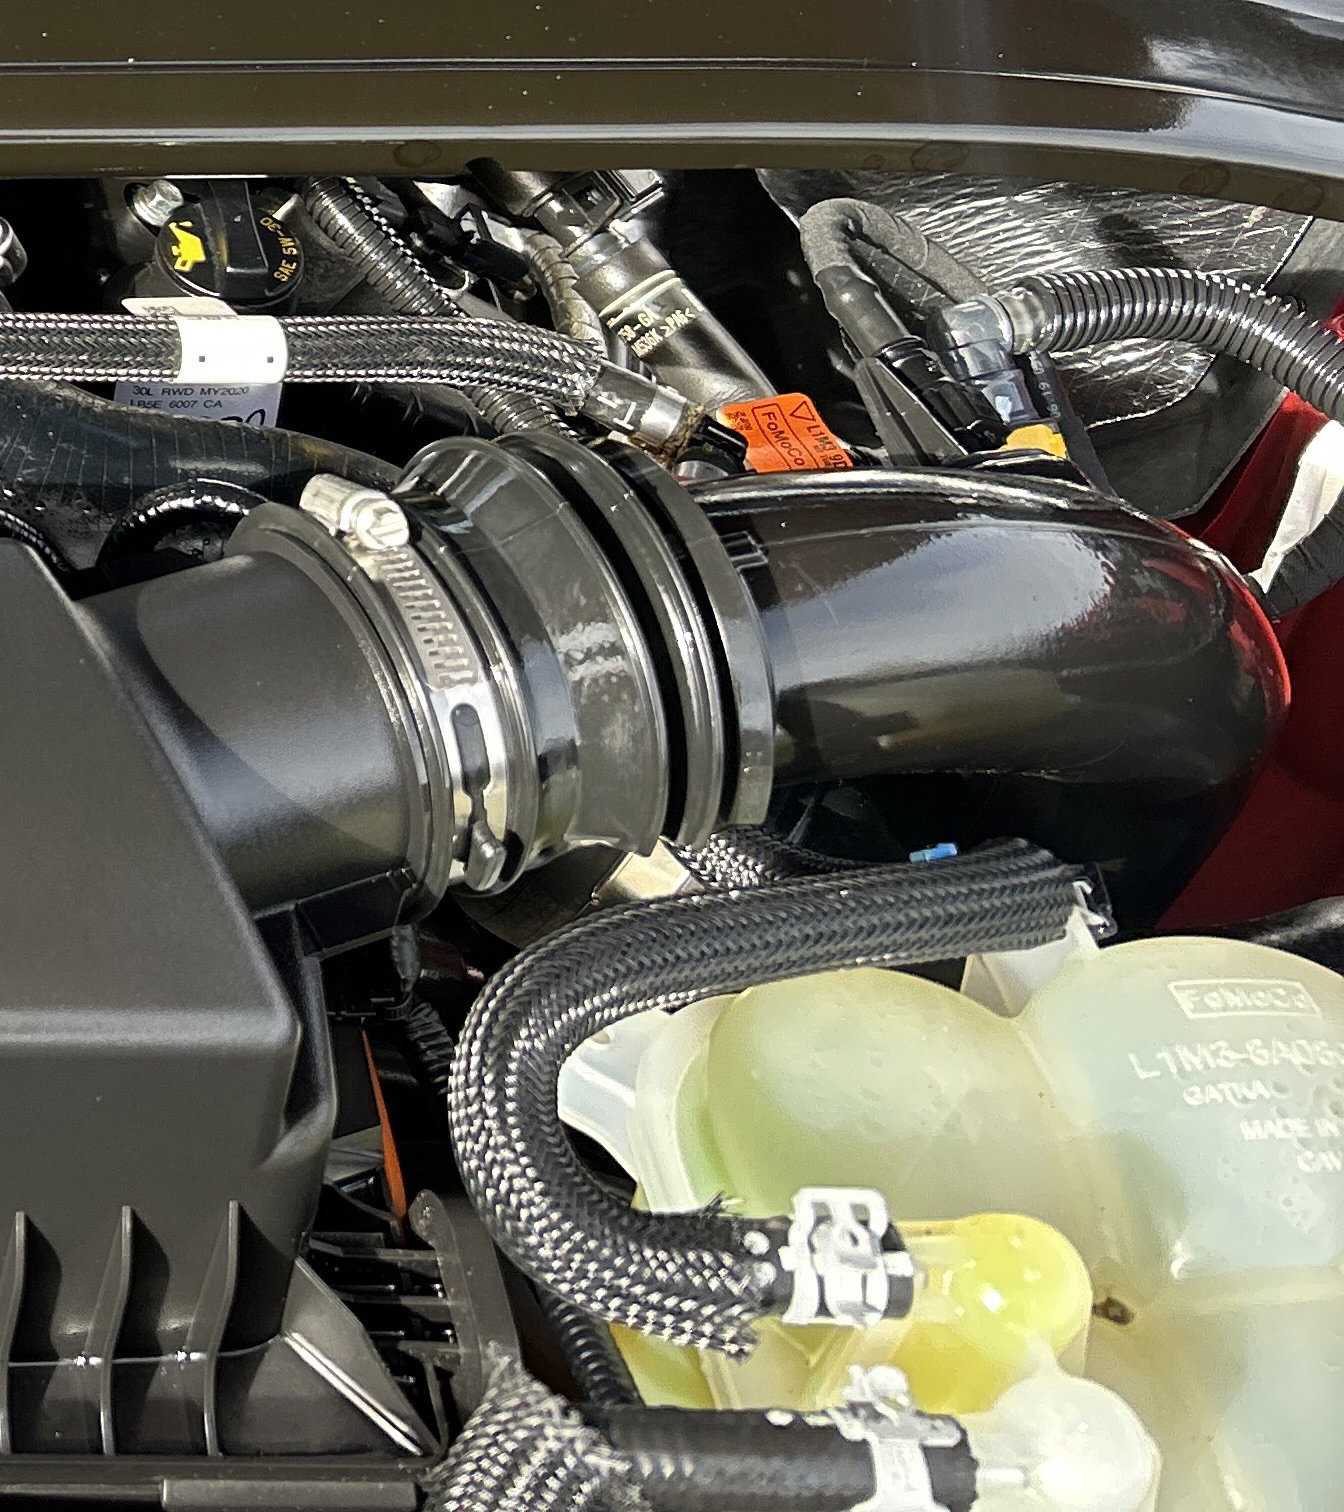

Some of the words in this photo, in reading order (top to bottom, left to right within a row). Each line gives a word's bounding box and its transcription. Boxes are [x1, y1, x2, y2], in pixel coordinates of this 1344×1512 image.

[259, 217, 298, 256] 5W-30
[273, 259, 297, 282] SAE
[162, 386, 194, 396] RWD
[200, 385, 250, 396] MY2020
[168, 399, 198, 409] 6007
[203, 399, 223, 409] CA
[761, 411, 806, 467] FoMoCo
[1179, 987, 1306, 1010] FoMoCo
[1239, 1118, 1312, 1141] MADE
